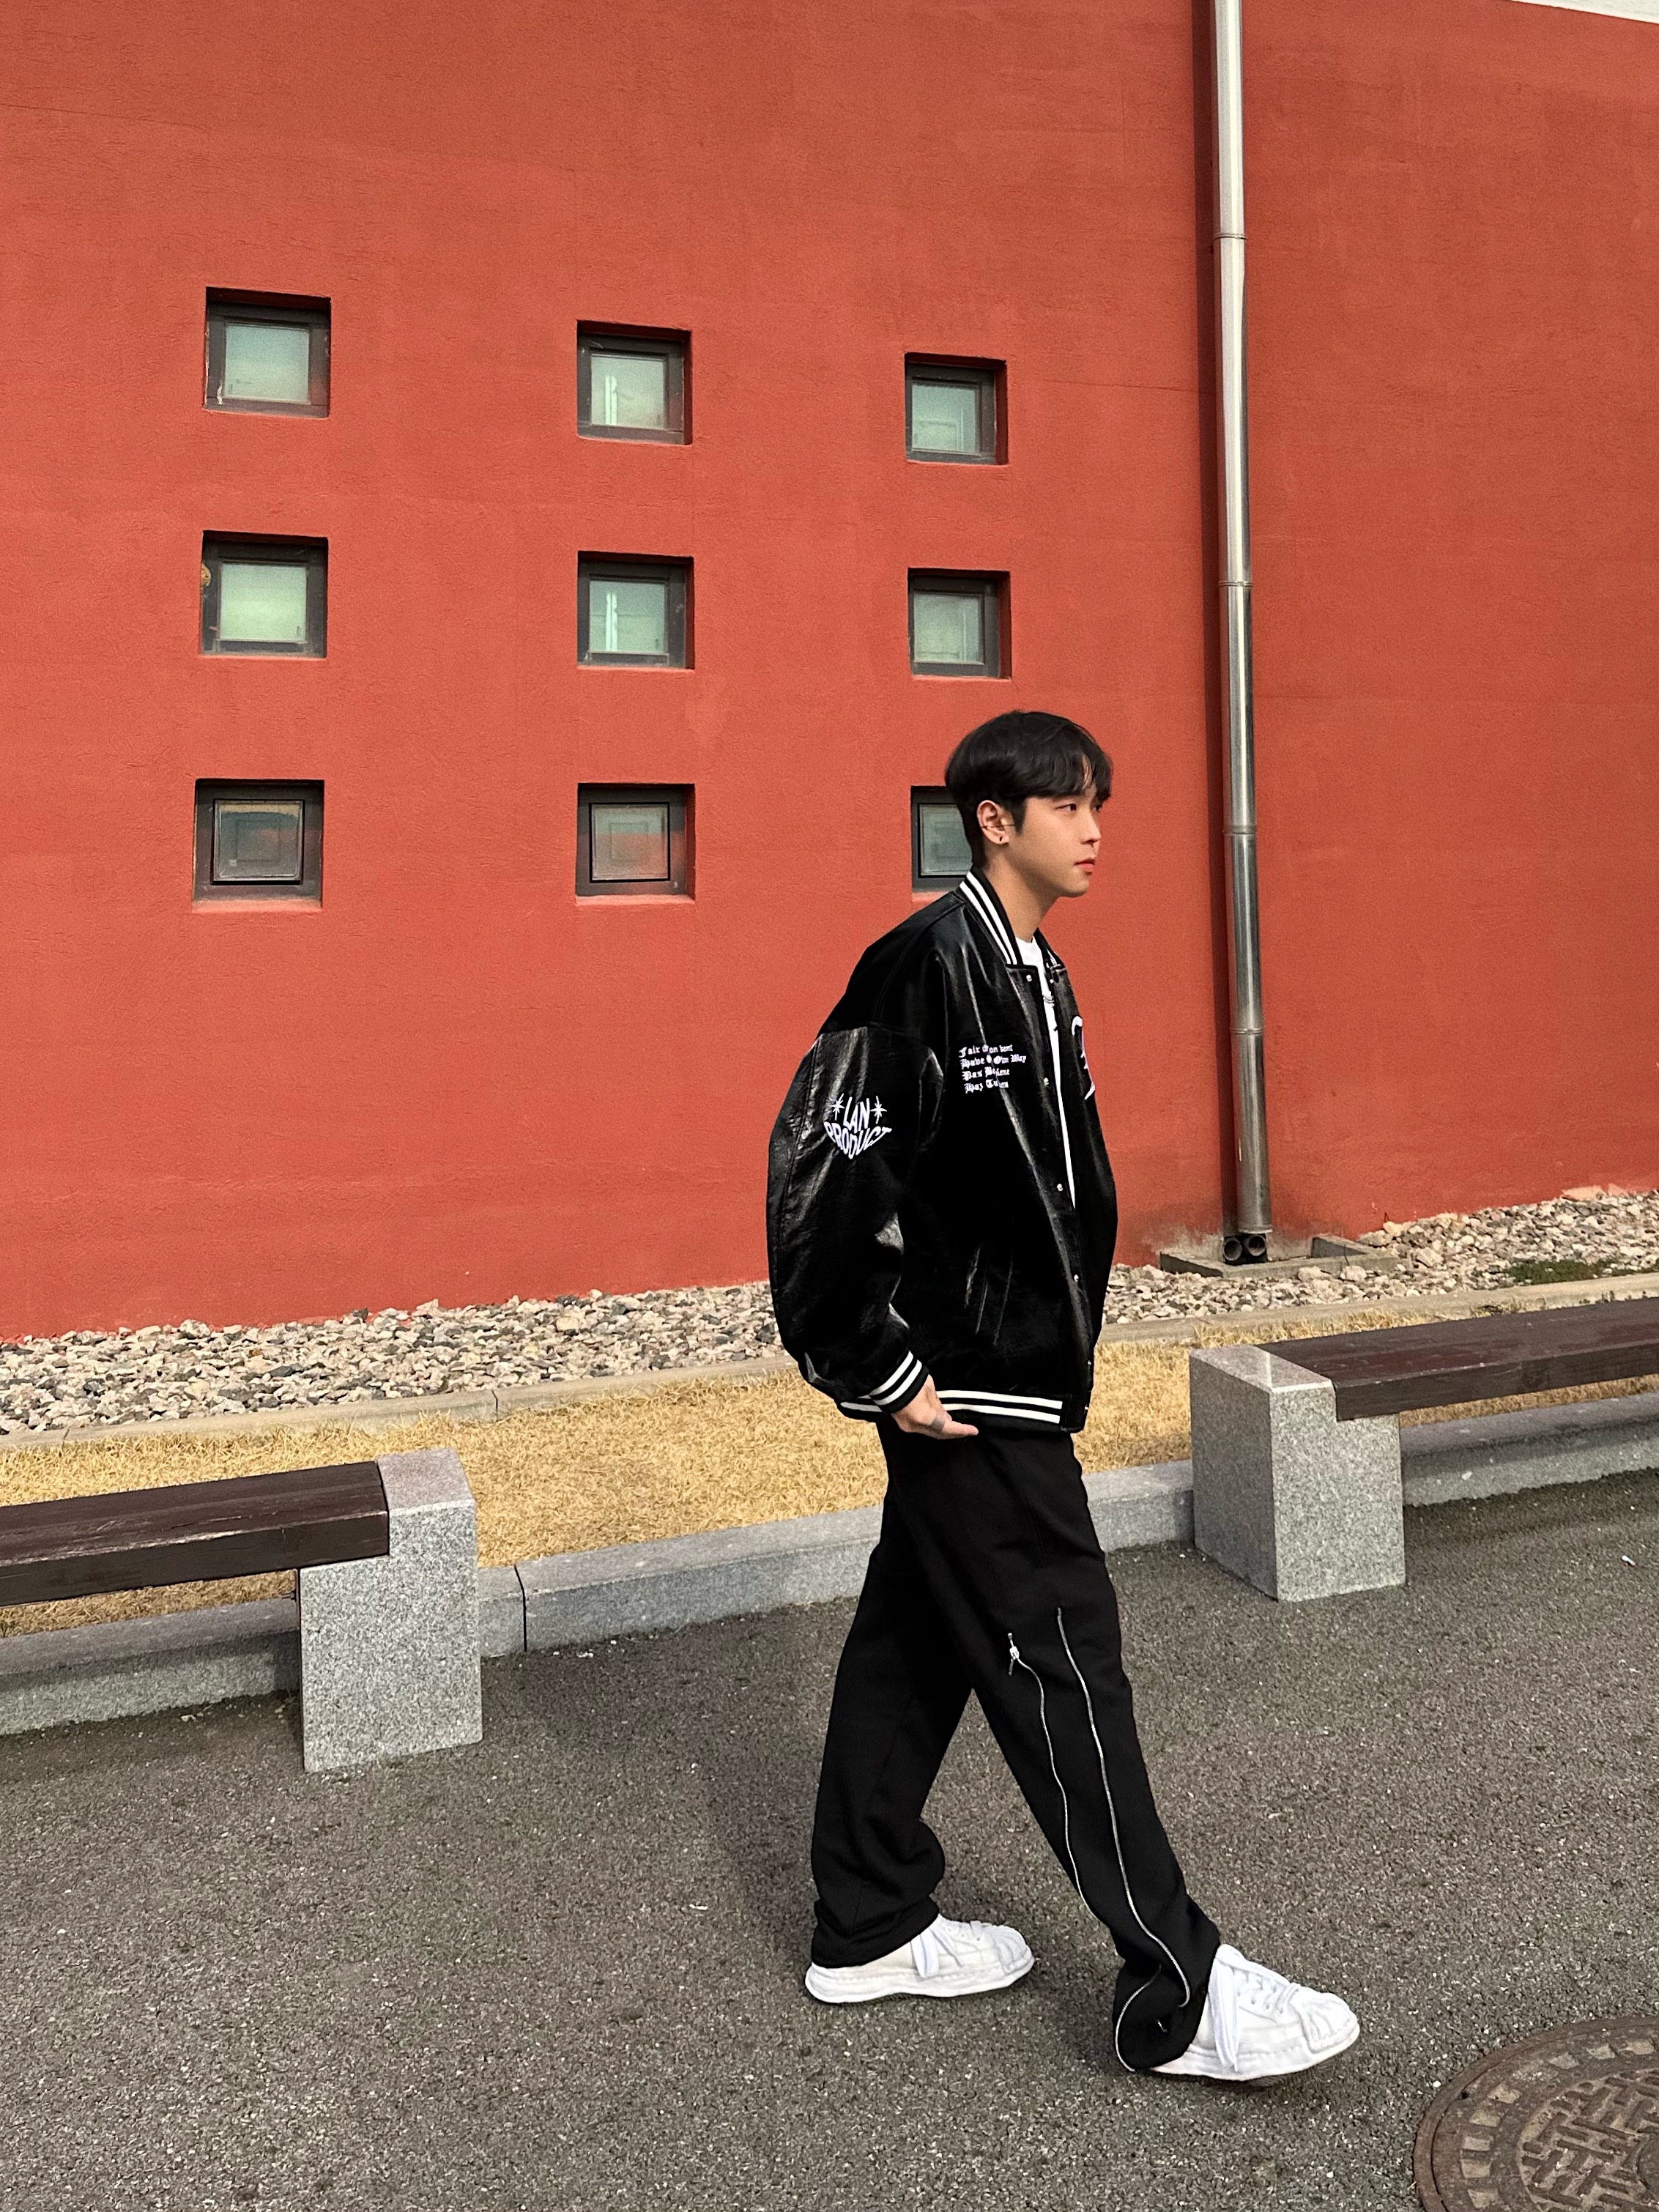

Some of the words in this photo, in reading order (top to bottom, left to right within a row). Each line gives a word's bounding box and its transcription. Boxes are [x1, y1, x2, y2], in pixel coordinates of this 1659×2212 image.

[959, 1045, 980, 1058] Fair
[843, 1096, 870, 1134] LAN
[824, 1121, 892, 1159] PRODUCT
